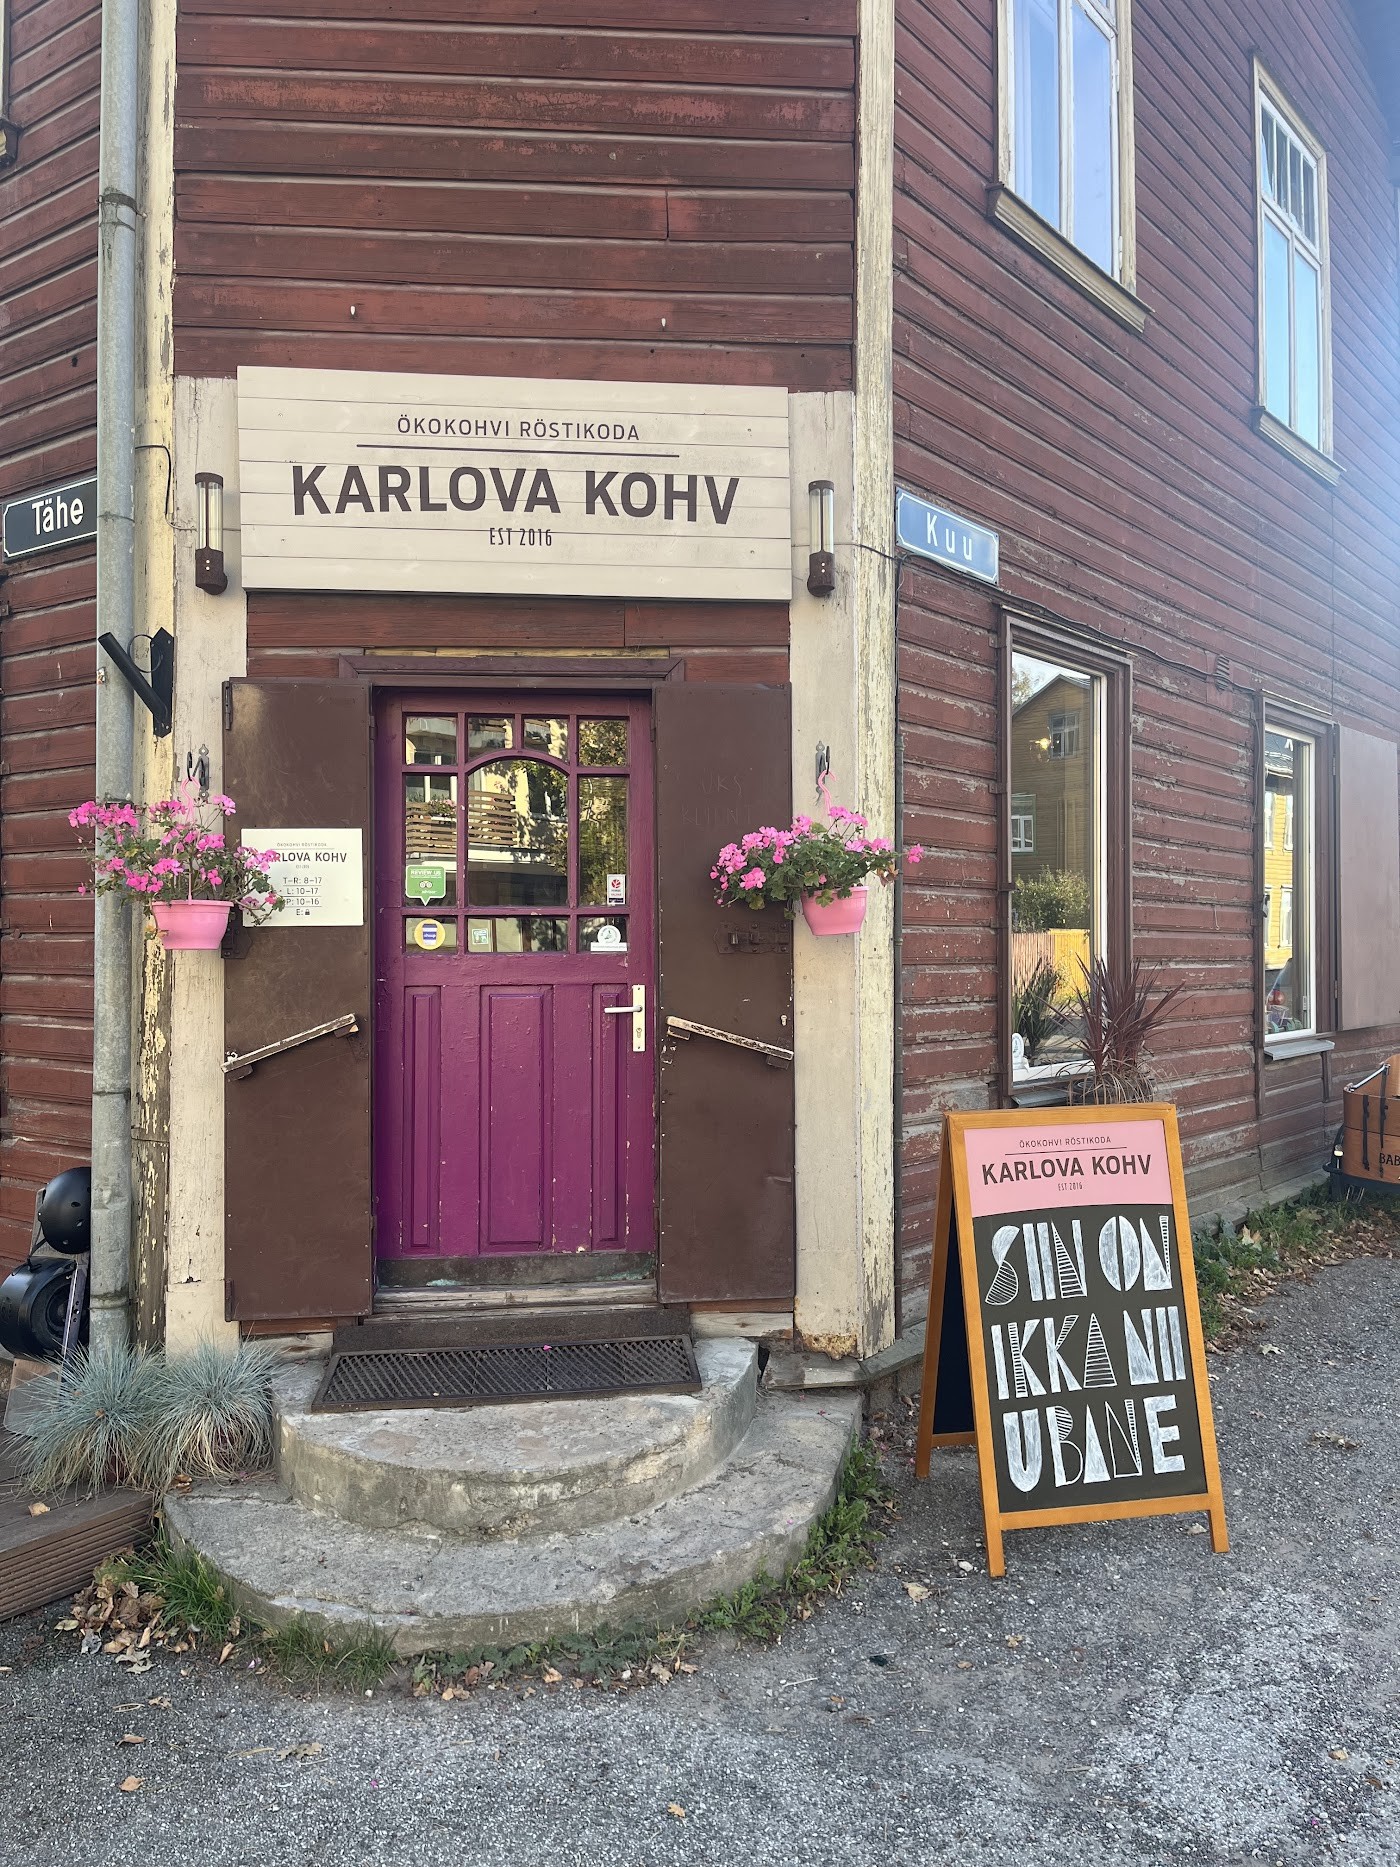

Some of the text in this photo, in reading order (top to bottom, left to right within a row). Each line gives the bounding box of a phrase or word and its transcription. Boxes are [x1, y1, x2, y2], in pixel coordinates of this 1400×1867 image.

[397, 414, 640, 441] ÖKOKOHVI RÖSTIKODA
[31, 495, 84, 536] Tähe
[292, 465, 740, 525] KARLOVA KOHV
[489, 527, 553, 547] EST 2016
[926, 511, 973, 561] Kuu
[315, 852, 347, 863] KOHV
[1019, 1139, 1062, 1149] ÖKOKOHVI
[981, 1154, 1152, 1186] KARLOVA KOHV
[985, 1215, 1173, 1306] SIIN ON
[990, 1305, 1187, 1401] IKKA NII
[1002, 1394, 1186, 1493] UBANE
